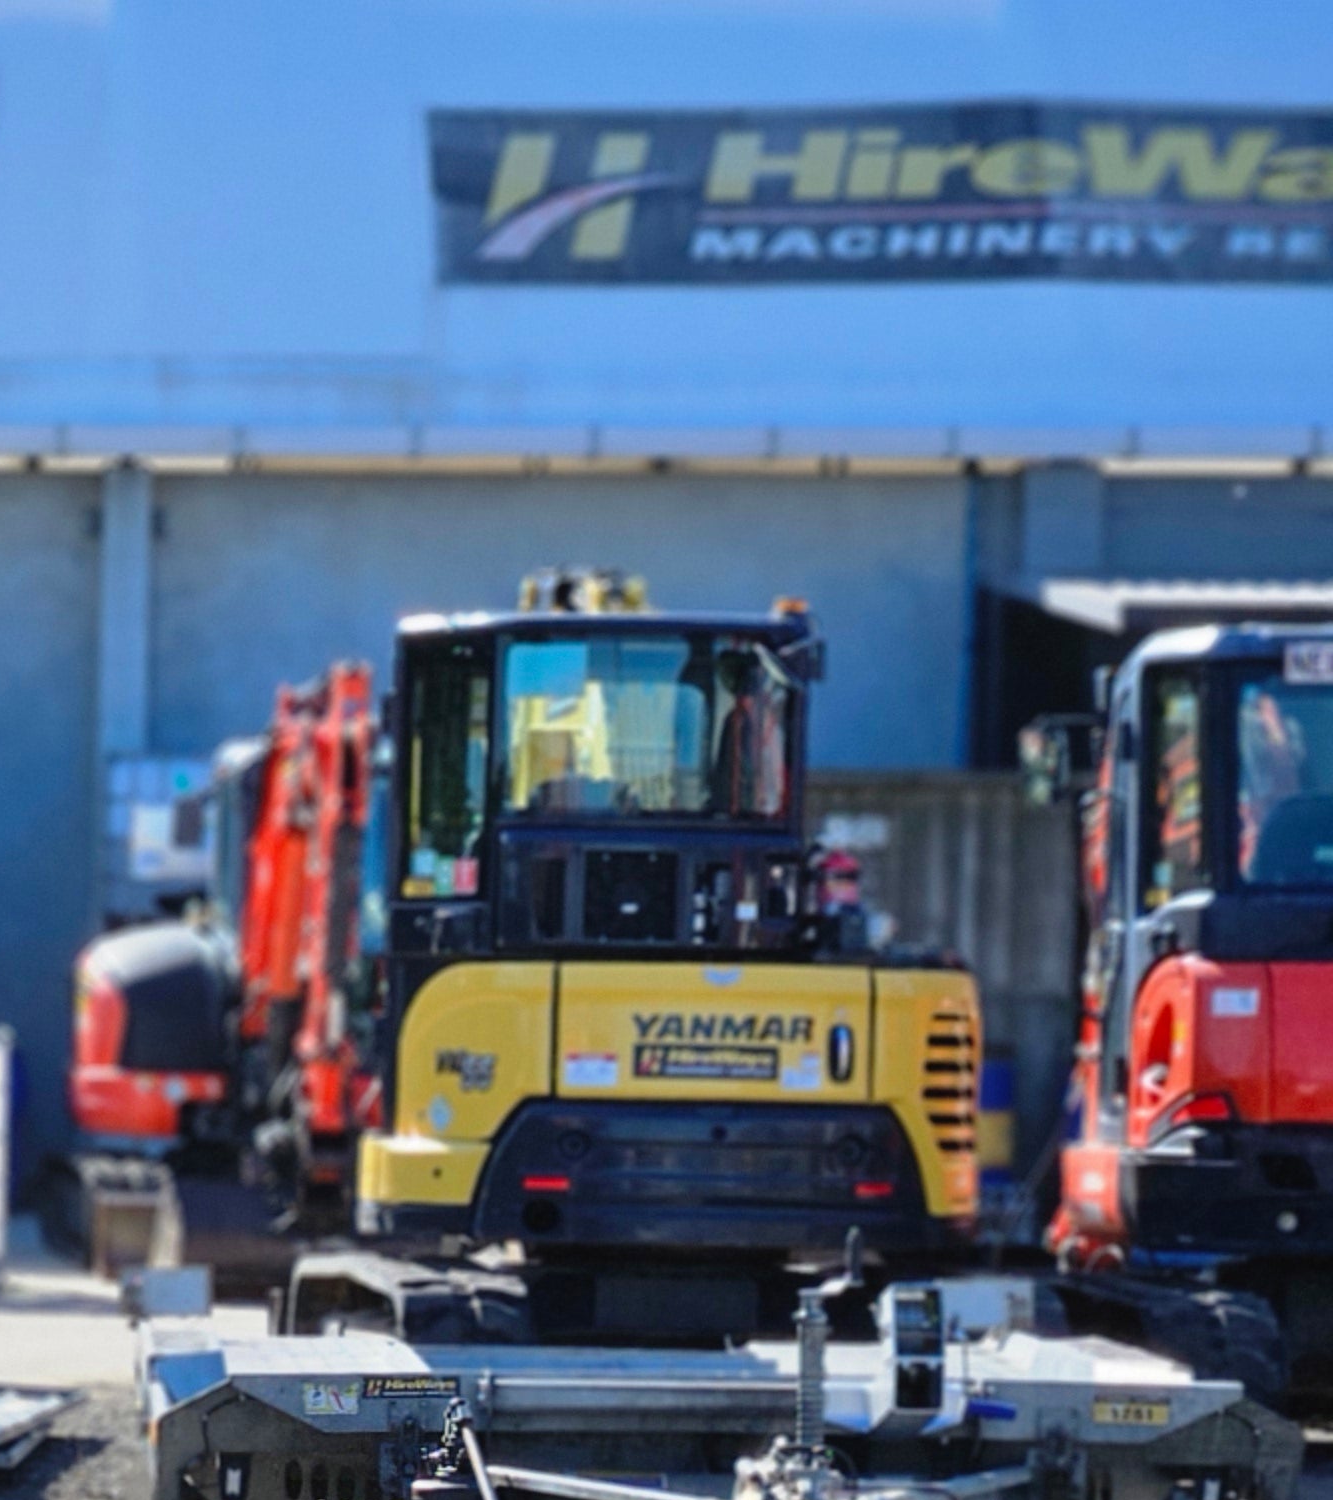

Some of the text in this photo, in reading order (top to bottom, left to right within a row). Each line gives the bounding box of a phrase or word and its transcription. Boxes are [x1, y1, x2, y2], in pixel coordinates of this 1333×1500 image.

[704, 123, 1333, 203] HireWa
[688, 222, 1193, 262] MACHINERY
[632, 1012, 812, 1042] YANMAR
